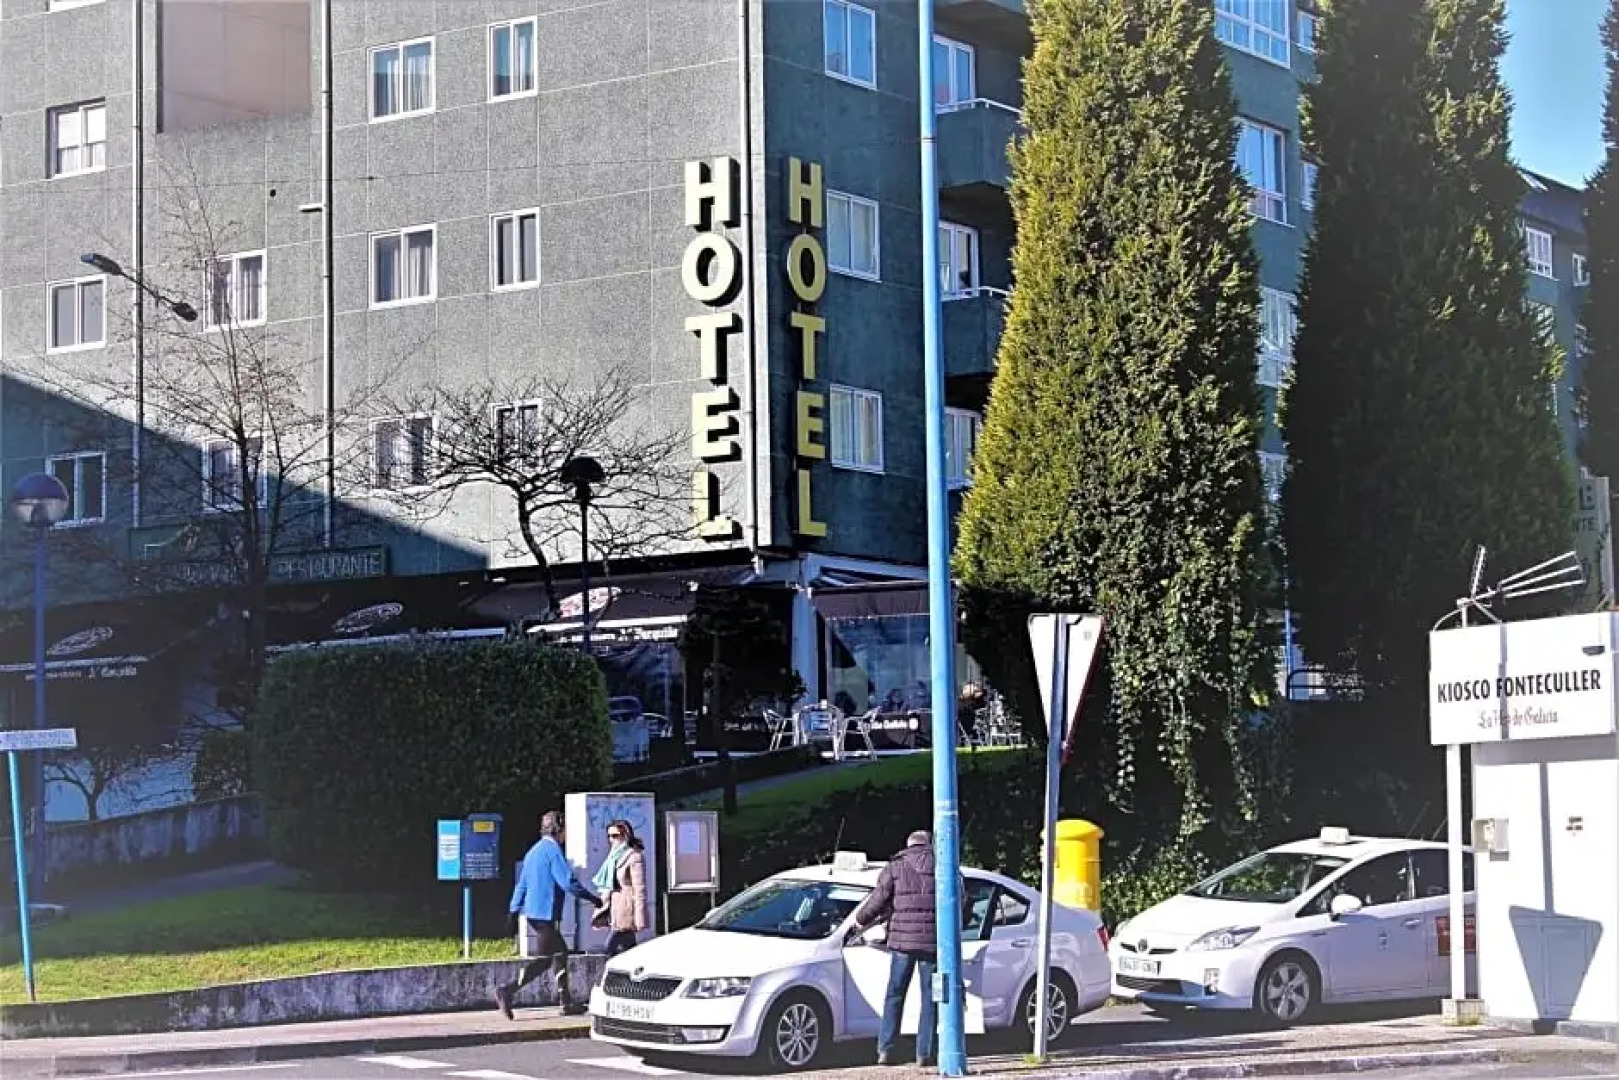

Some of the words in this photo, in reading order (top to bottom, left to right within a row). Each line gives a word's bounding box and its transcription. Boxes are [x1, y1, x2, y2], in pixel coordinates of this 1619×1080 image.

[682, 156, 738, 539] HOTEL
[787, 156, 827, 538] HOTEL
[1437, 679, 1491, 703] KIOSCO
[1496, 669, 1601, 698] FONTECULLER
